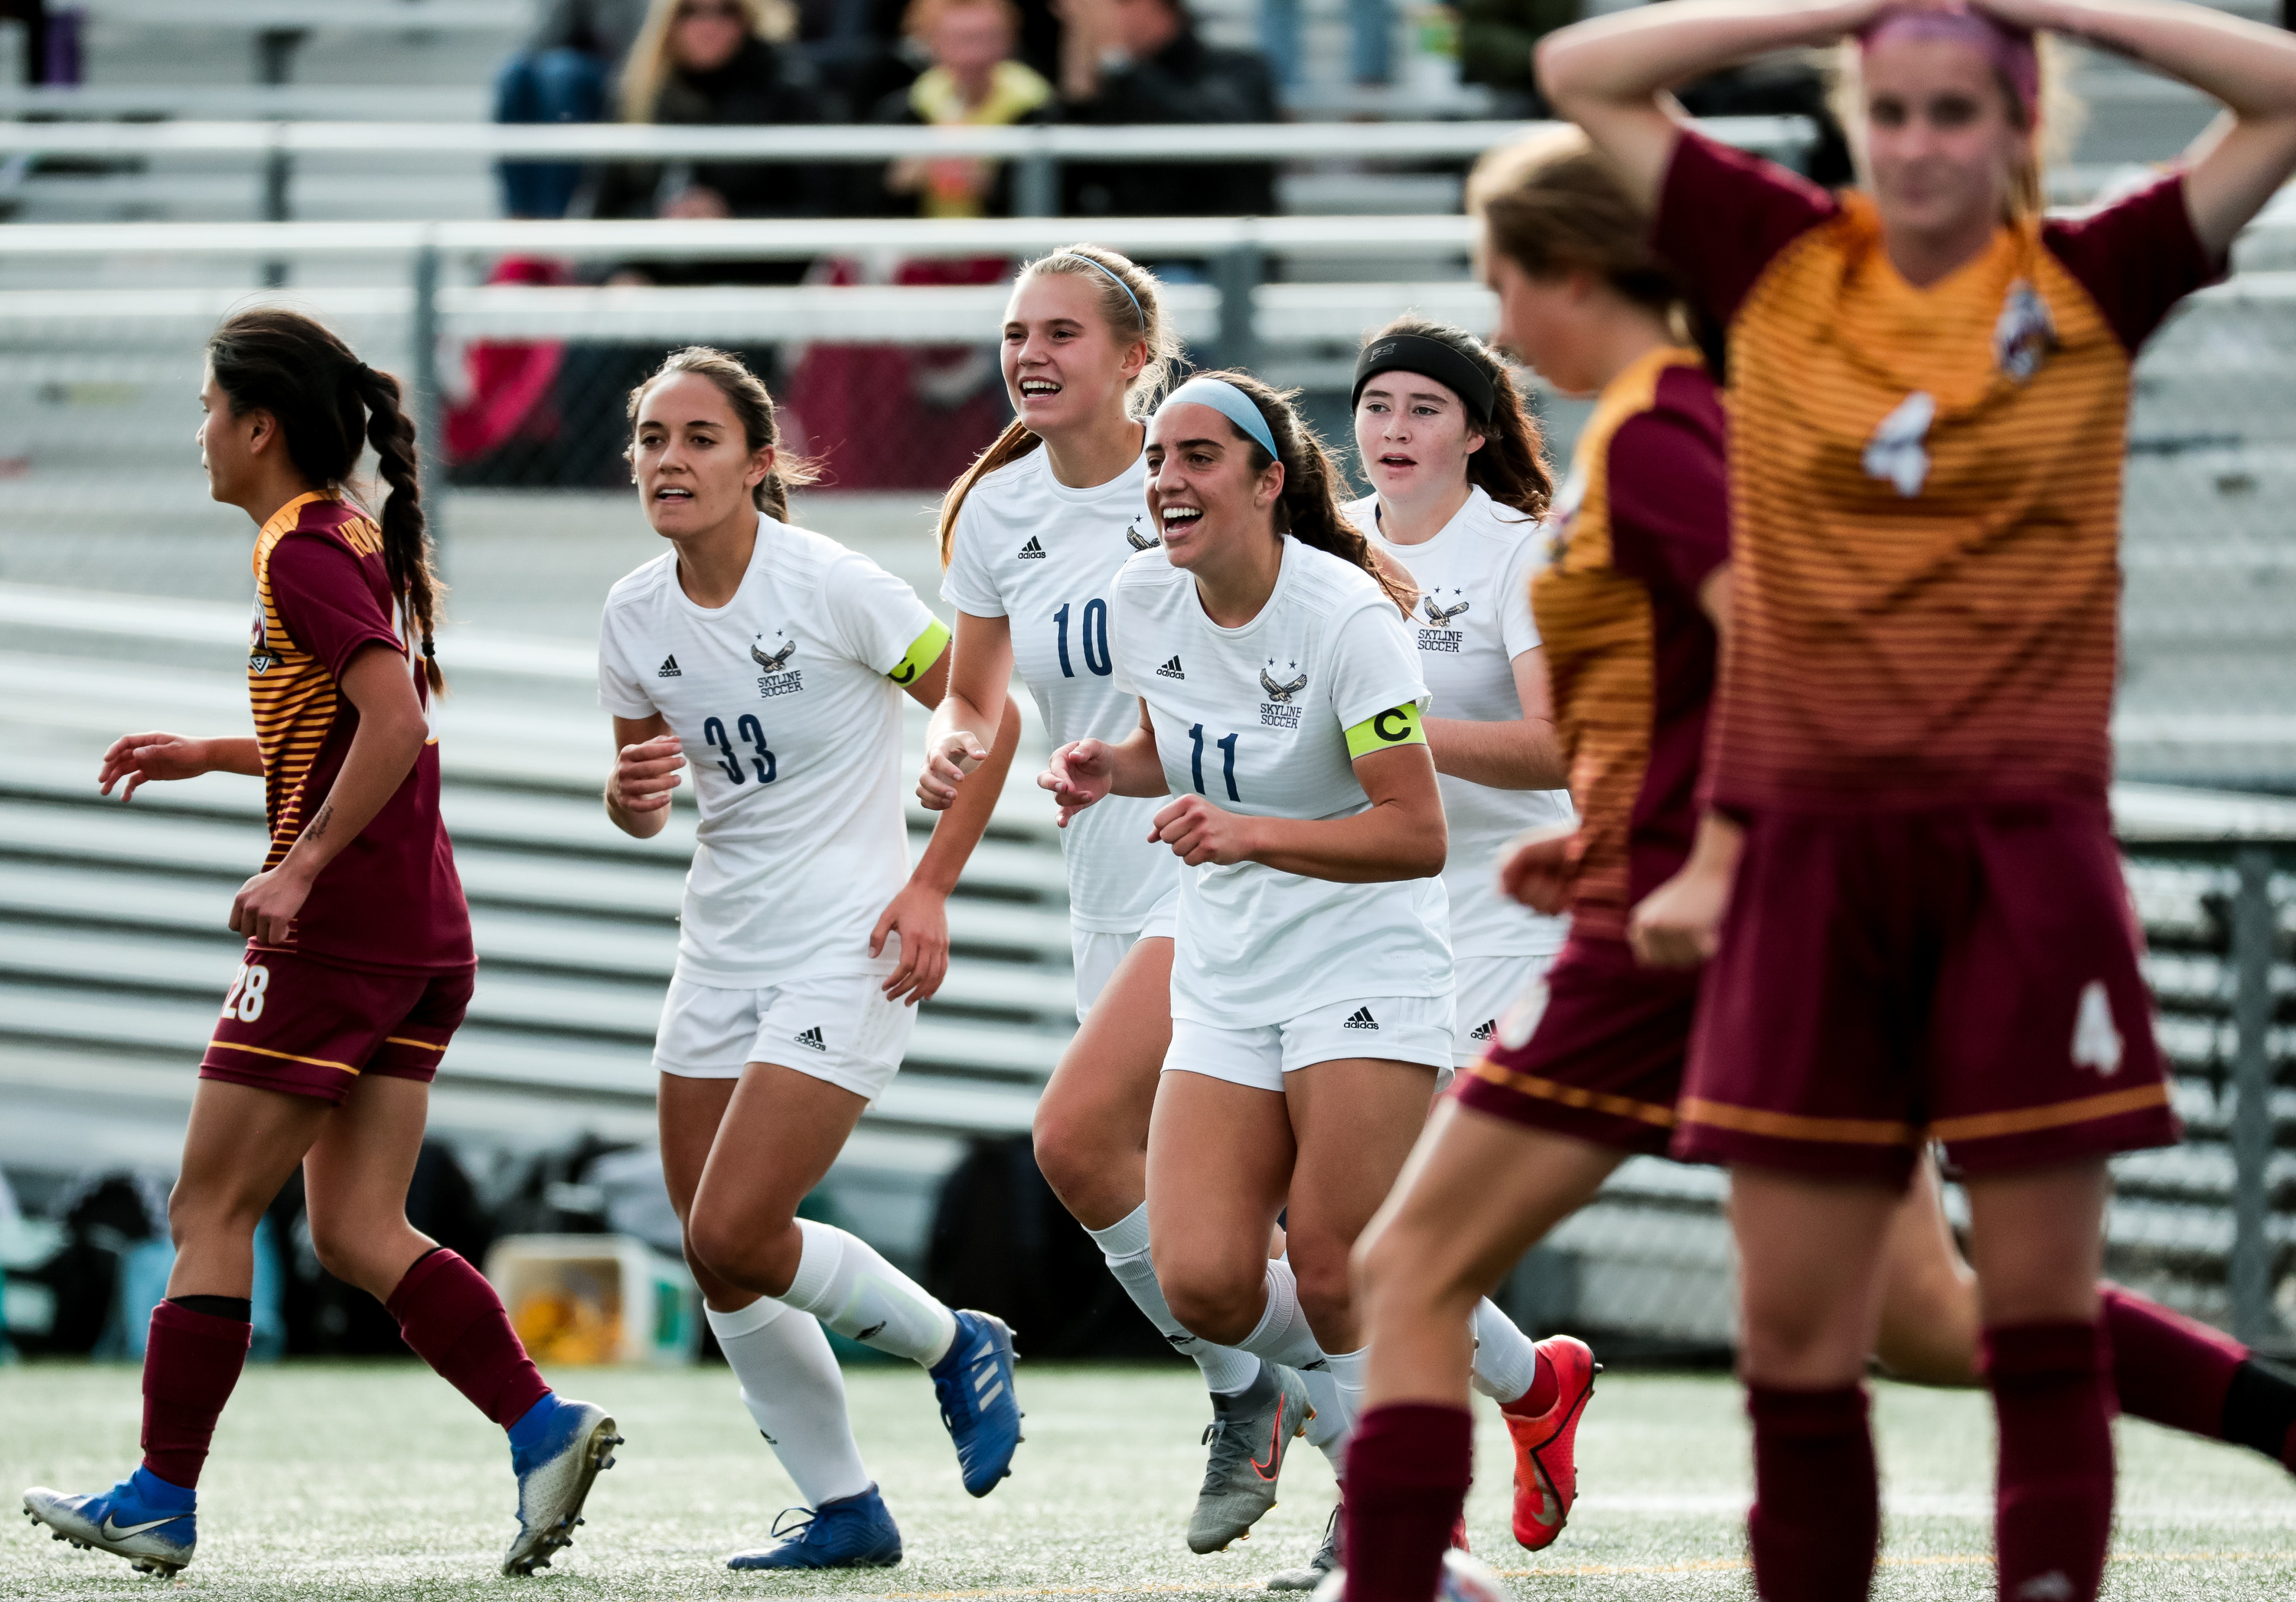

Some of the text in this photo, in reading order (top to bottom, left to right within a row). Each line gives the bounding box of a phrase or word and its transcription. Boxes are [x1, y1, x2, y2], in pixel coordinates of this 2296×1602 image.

[1861, 391, 1935, 498] 4
[1018, 550, 1046, 560] adidas
[1053, 599, 1113, 677] 10
[1418, 629, 1463, 642] SKYLINE
[1418, 641, 1459, 653] SOCCER
[658, 669, 682, 677] adidas
[758, 670, 803, 687] SKYLINE
[1156, 668, 1185, 680] adidas
[761, 681, 804, 698] SOCCER
[1261, 703, 1302, 718] SKYLINE
[1261, 714, 1297, 729] SOCCER
[1374, 708, 1411, 742] C
[704, 713, 777, 785] 33
[1189, 723, 1241, 802] 11
[221, 962, 269, 1023] 28
[1343, 1020, 1379, 1030] adidas
[2071, 978, 2125, 1078] 4
[794, 1036, 827, 1052] adidas
[1470, 1031, 1498, 1042] adida
